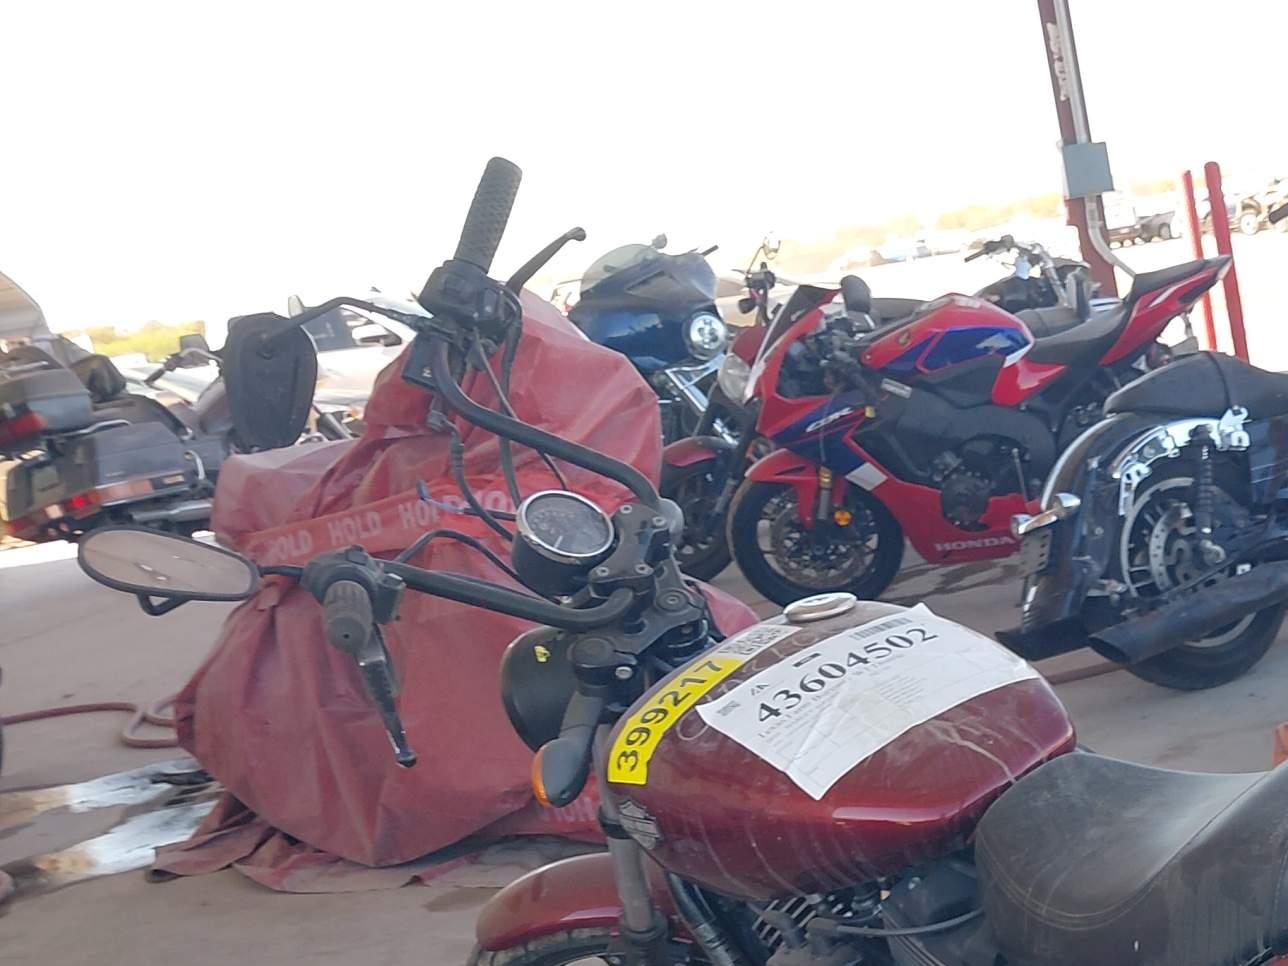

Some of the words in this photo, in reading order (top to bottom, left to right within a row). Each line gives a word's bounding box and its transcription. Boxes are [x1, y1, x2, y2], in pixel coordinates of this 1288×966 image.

[327, 511, 382, 547] HOLD
[934, 536, 1017, 551] HONDA
[758, 628, 939, 722] 43604502
[617, 660, 722, 772] 399217
